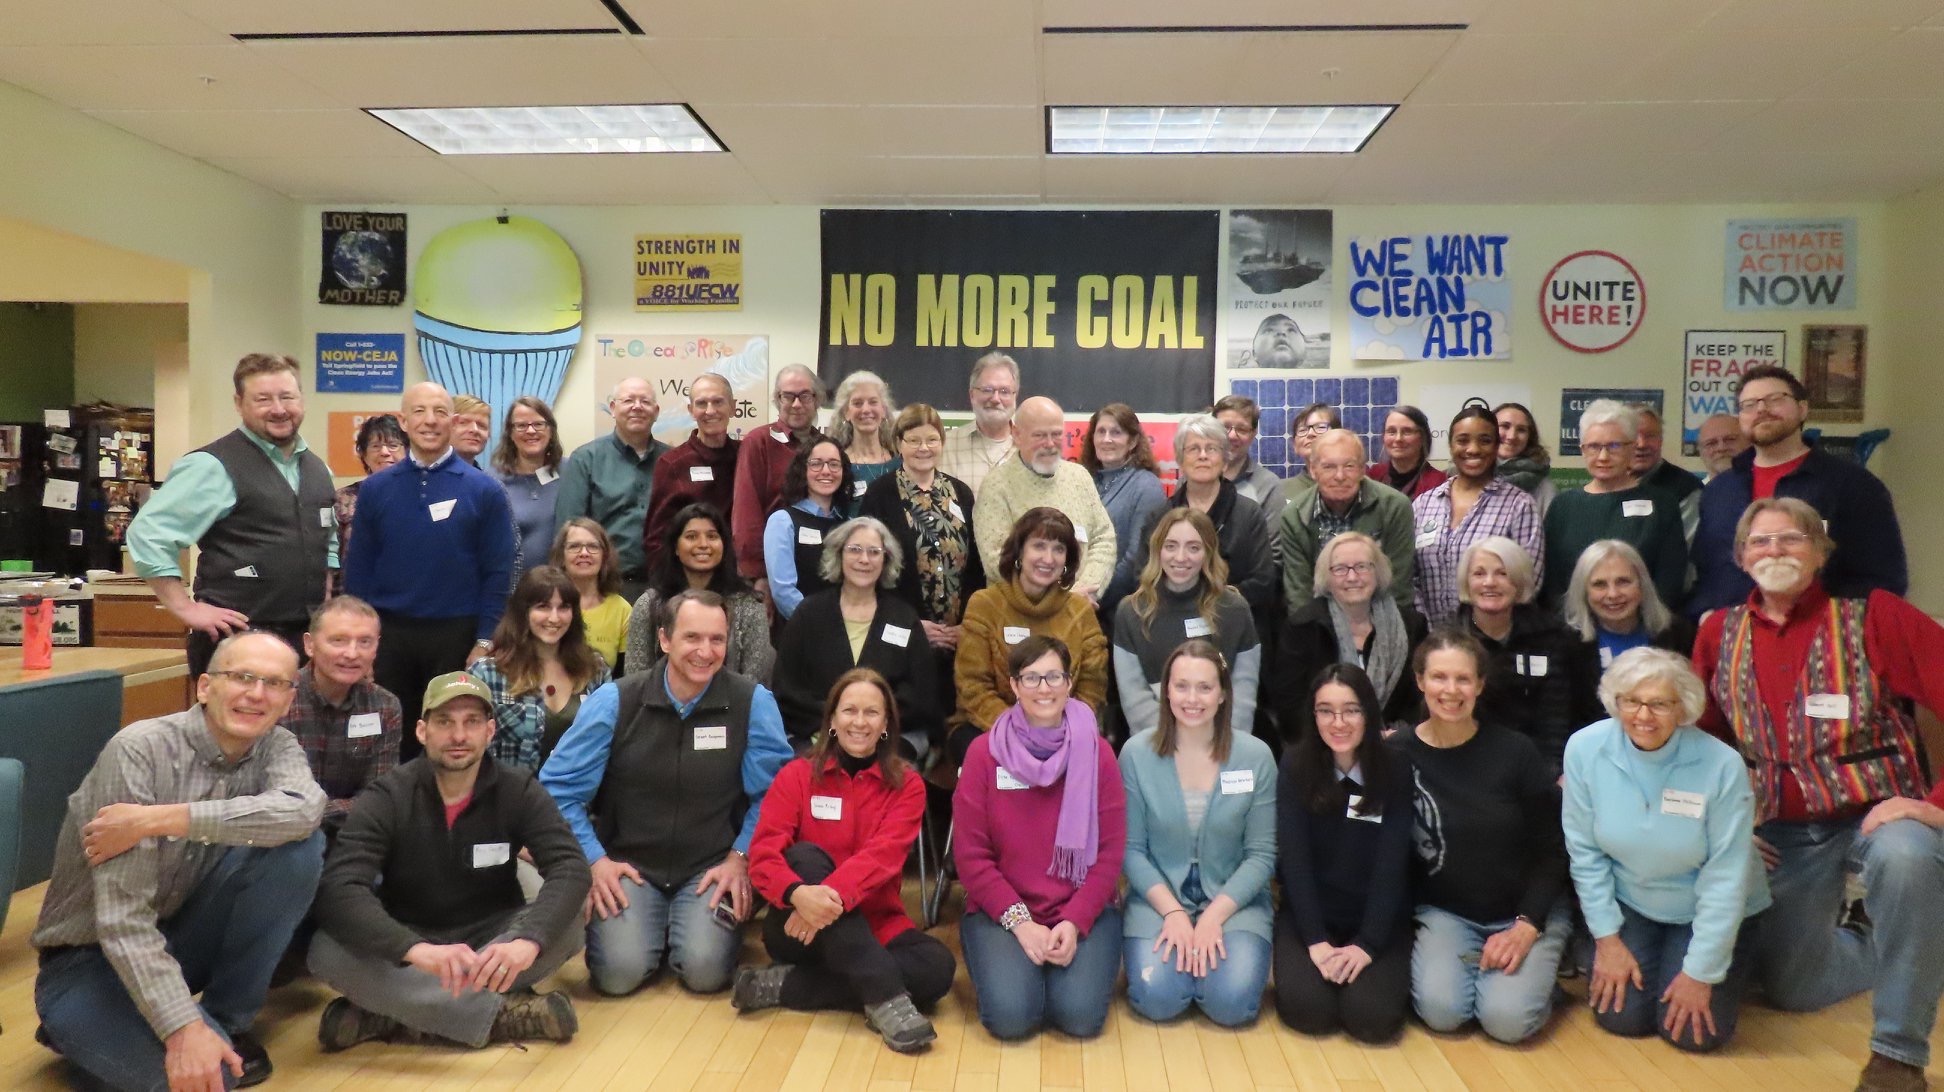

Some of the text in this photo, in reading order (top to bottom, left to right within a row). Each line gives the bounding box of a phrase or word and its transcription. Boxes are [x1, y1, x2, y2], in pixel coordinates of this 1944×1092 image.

[324, 213, 404, 231] LOVE YOUR
[637, 240, 740, 255] STRENGTH IN
[1738, 232, 1844, 250] CLIMATE
[1350, 234, 1509, 278] WE WANT
[1739, 253, 1844, 272] ACTION
[637, 261, 685, 276] UNITY
[323, 289, 400, 304] MOTHER
[1551, 280, 1635, 302] UNITE
[1738, 274, 1845, 305] NOW
[829, 273, 1204, 350] NO MORE COAL
[1235, 300, 1324, 310] PROTECT OUR FUTURE
[1550, 305, 1634, 327] HERE!
[1422, 310, 1493, 358] AIR
[321, 350, 399, 362] NOW-CEJA
[1695, 344, 1775, 357] KEEP THE
[660, 378, 691, 397] We
[1689, 381, 1721, 393] OUT
[734, 399, 758, 419] ote
